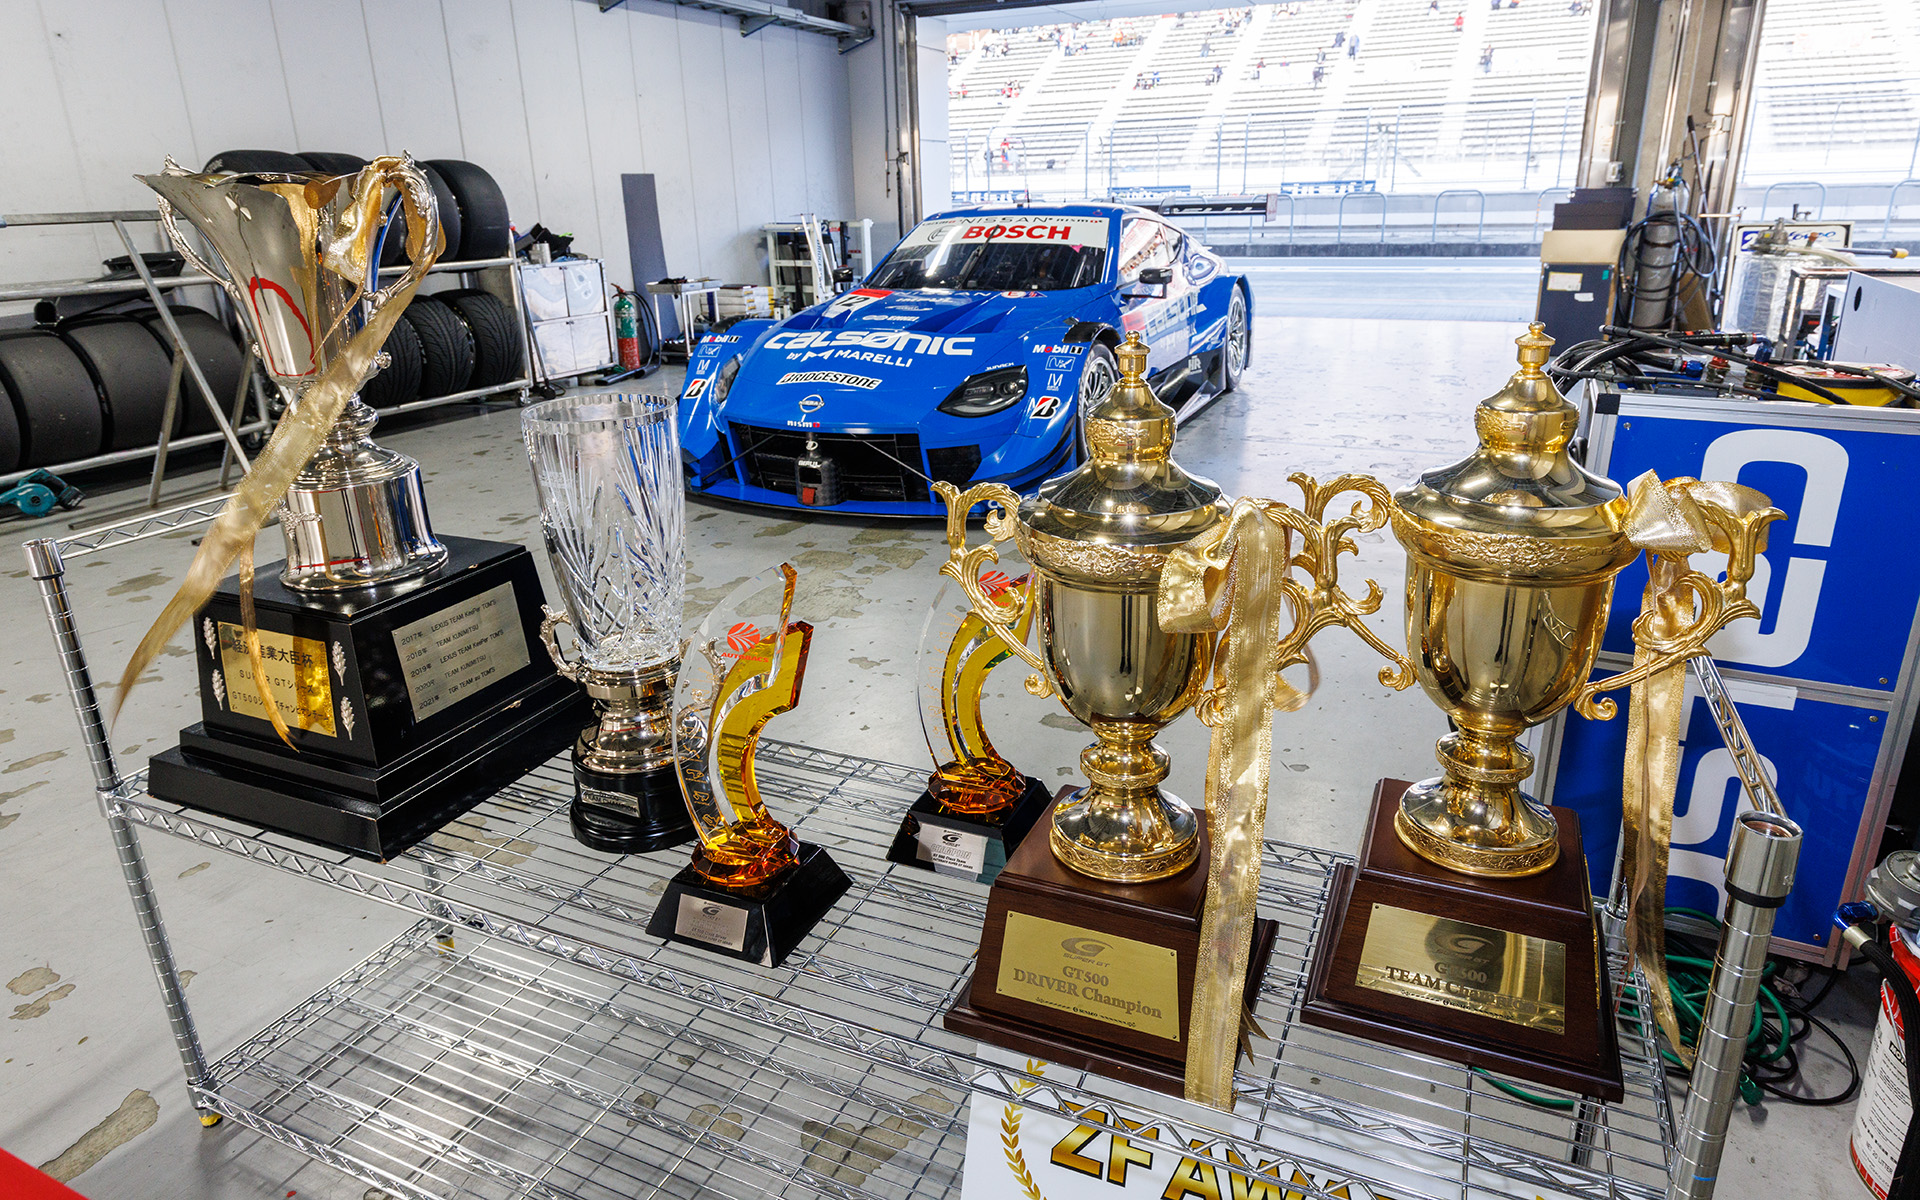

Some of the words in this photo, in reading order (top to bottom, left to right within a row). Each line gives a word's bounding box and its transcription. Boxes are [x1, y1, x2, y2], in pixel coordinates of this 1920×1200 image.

[961, 225, 1072, 240] BOSCH
[835, 295, 869, 308] 12
[701, 335, 728, 343] Mobil
[1032, 345, 1067, 354] Mobil
[786, 352, 801, 362] by
[836, 350, 913, 367] MARELLI
[782, 372, 878, 388] BRIDGESTONE
[430, 619, 449, 632] LEXUS
[449, 613, 464, 624] TEAM
[436, 637, 451, 648] TEAM
[452, 624, 479, 640] KUNIMITSU
[440, 651, 457, 664] LEXUS
[457, 645, 472, 656] TEAM
[721, 652, 769, 663] AUTOBACS
[240, 669, 271, 685] SUPR
[444, 667, 459, 679] TEAM
[459, 678, 474, 689] TEAM
[1063, 953, 1095, 965] SUPER
[1062, 966, 1110, 987] GT500
[1386, 965, 1441, 991] TEAM
[1013, 968, 1080, 997] DRIVER
[1081, 986, 1162, 1019] Champion
[1051, 1100, 1161, 1188] ZF
